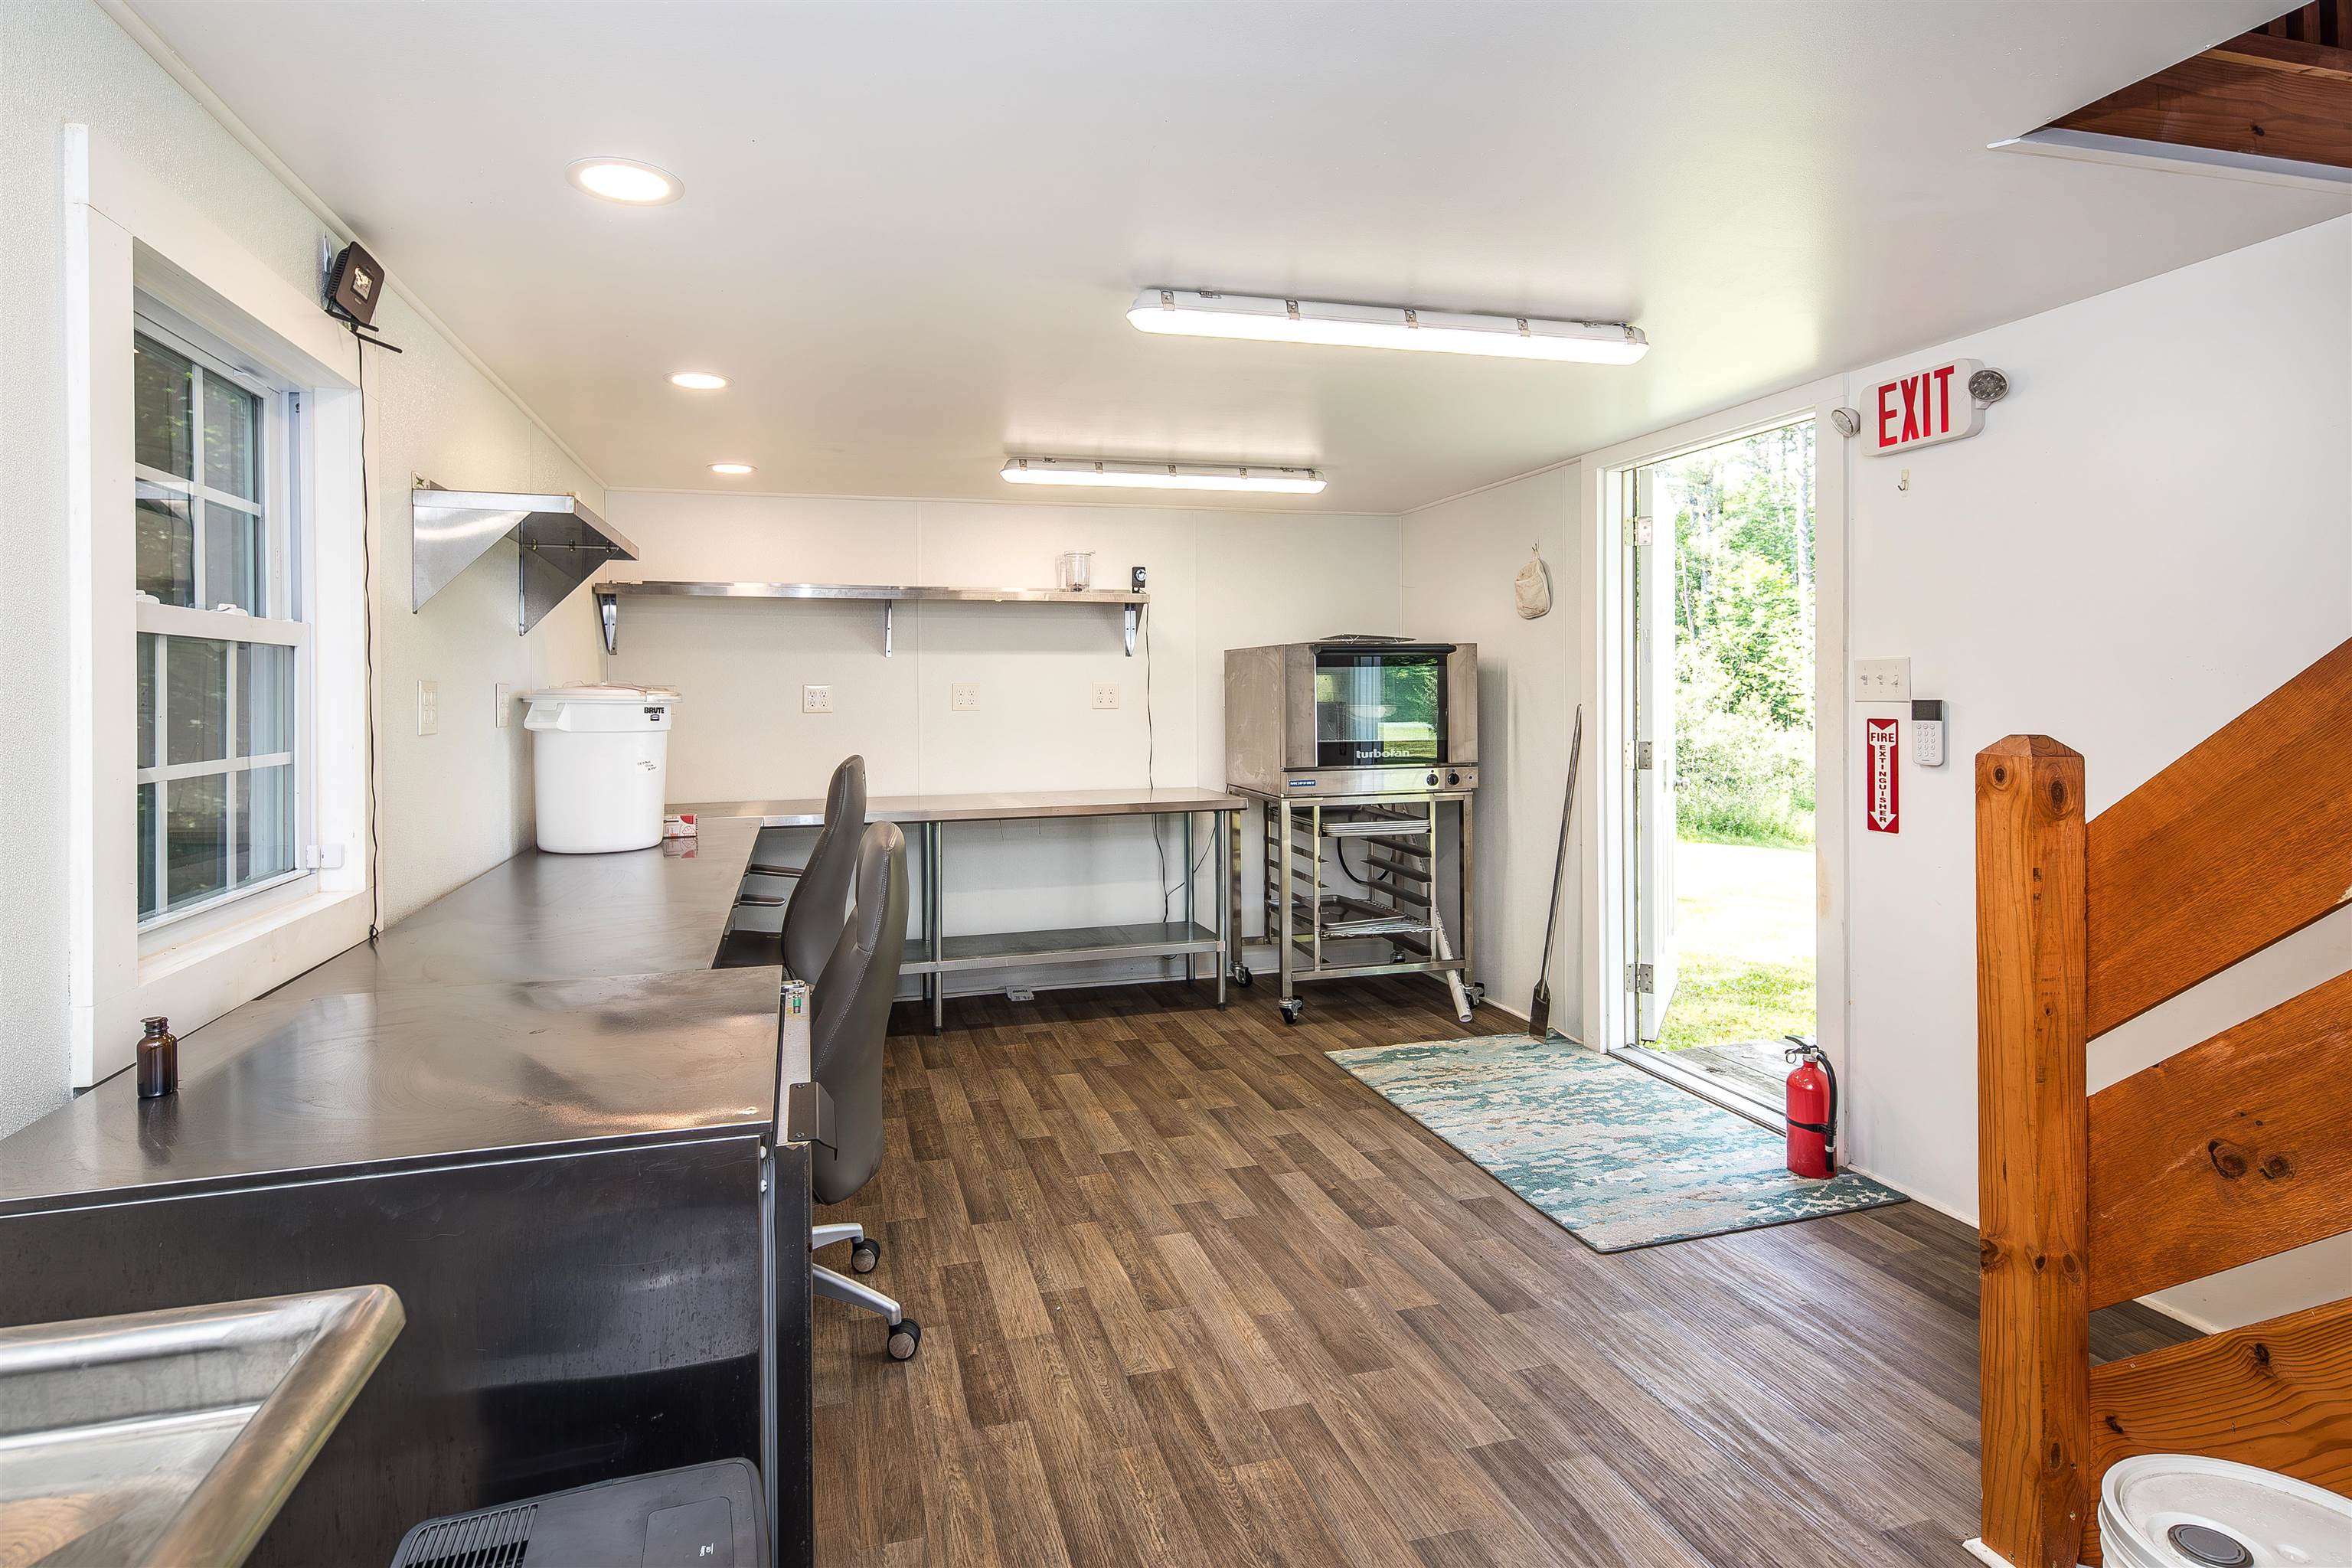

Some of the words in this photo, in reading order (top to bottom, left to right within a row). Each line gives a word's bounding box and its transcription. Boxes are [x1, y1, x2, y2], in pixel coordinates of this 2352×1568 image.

[1878, 365, 1955, 448] EXIT
[1356, 748, 1410, 759] turbofan
[1870, 733, 1895, 743] FIRE
[1879, 745, 1887, 823] EXTINGUISHER
